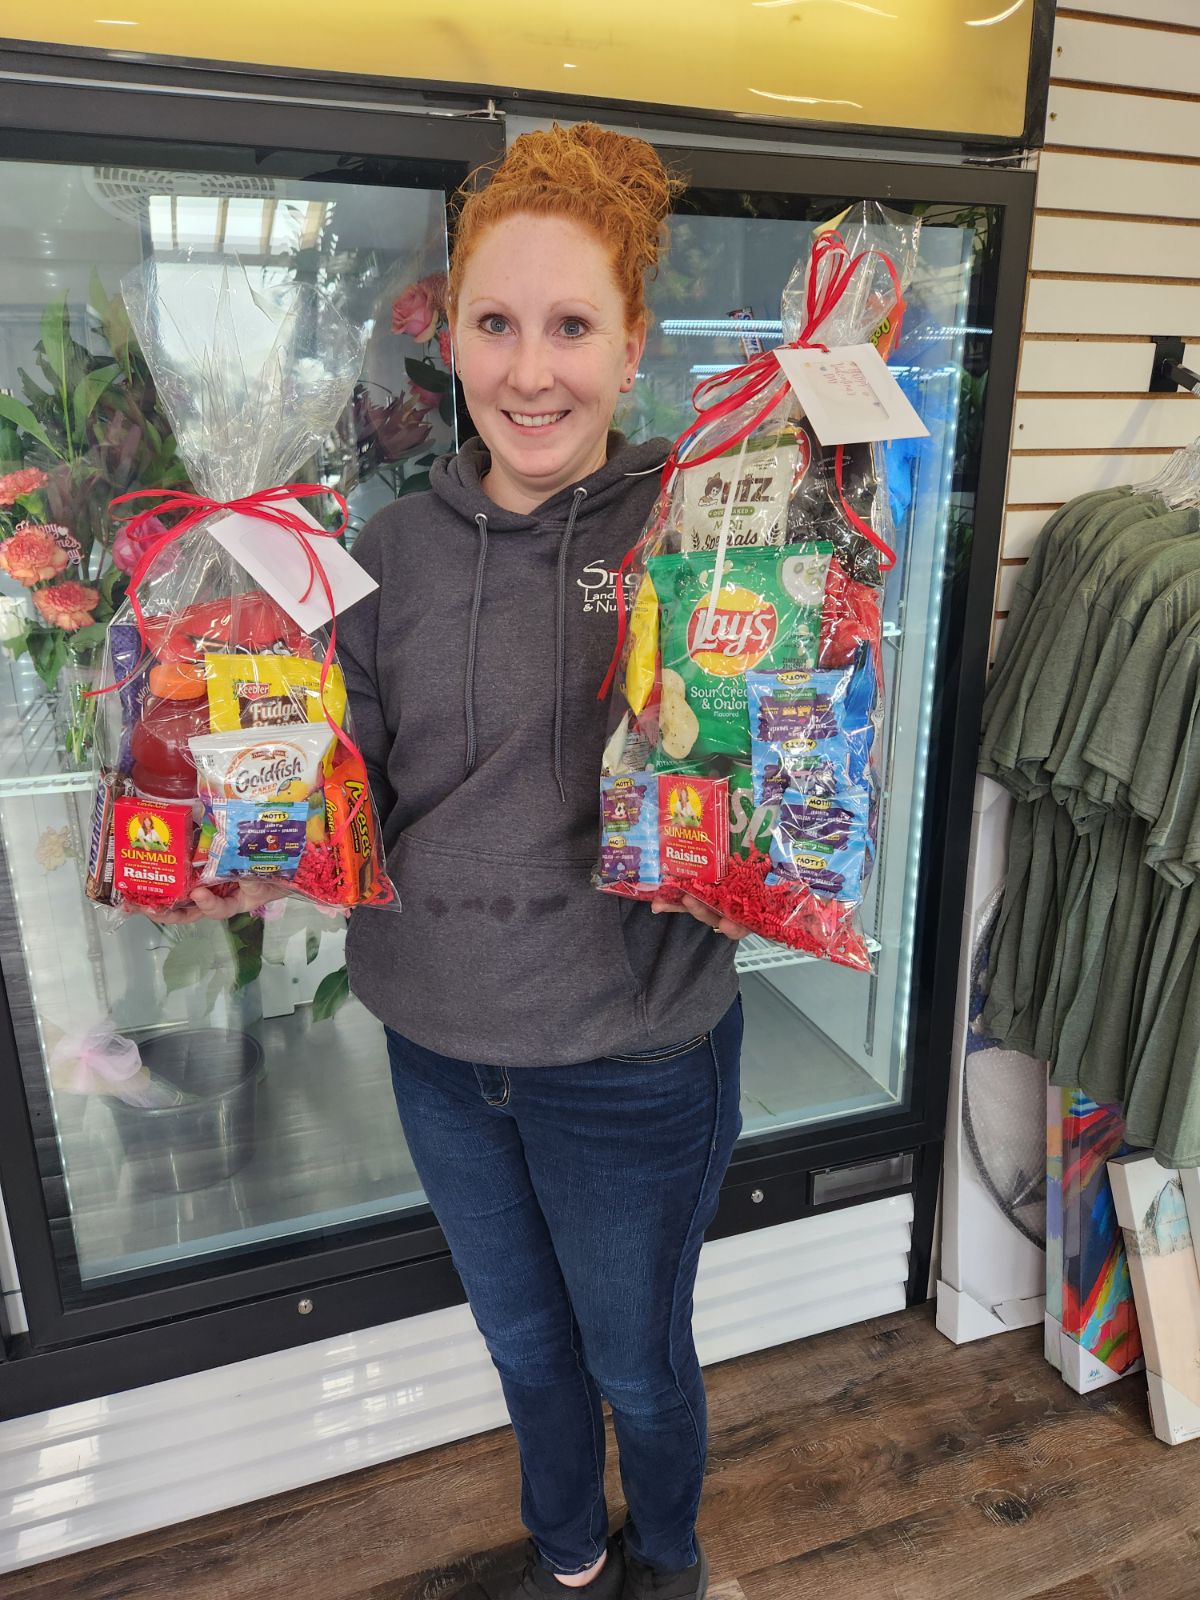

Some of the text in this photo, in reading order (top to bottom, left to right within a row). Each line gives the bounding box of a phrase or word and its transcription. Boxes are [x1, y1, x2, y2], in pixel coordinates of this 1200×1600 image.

[713, 519, 744, 532] MNI
[701, 529, 759, 551] Speials
[576, 559, 642, 589] Sno
[690, 608, 775, 657] Lay's
[237, 682, 270, 695] Keebler
[690, 686, 716, 699] Sour
[250, 698, 303, 721] Fudge
[701, 699, 711, 710] &
[235, 756, 302, 793] Goldfish
[344, 780, 372, 859] Rese's
[663, 826, 709, 843] SUN-MAID
[120, 848, 177, 865] SUN-MAID
[664, 846, 708, 865] Raisins
[123, 866, 177, 884] Raisins
